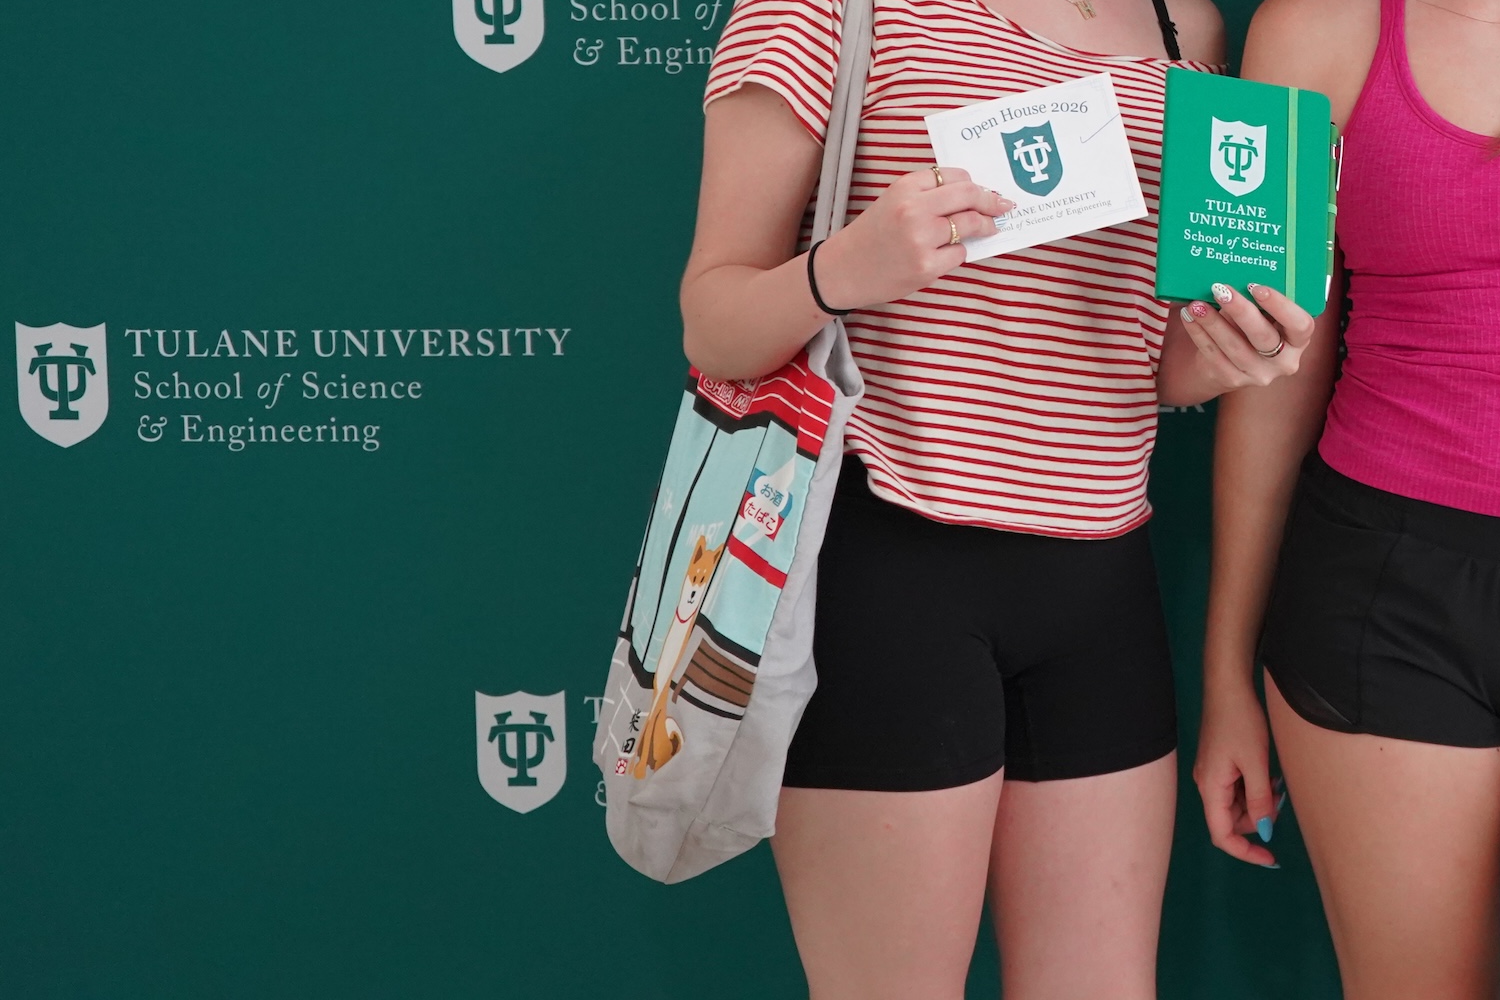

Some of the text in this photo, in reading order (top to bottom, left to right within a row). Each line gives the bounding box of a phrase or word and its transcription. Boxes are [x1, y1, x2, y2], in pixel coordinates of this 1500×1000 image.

[572, 37, 604, 66] &
[960, 100, 1089, 143] Open House 2026
[1003, 190, 1097, 221] ULANE UNIVERSITY
[1015, 221, 1025, 232] of
[1025, 213, 1054, 227] Science
[1065, 199, 1112, 217] Engineering
[1205, 198, 1267, 219] TULANE
[1189, 211, 1282, 236] UNIVERSITY
[1183, 228, 1285, 254] School of Science
[1190, 245, 1278, 271] & Engineering
[124, 327, 571, 358] TULANE UNIVERSITY
[134, 371, 422, 410] School of Science
[137, 414, 381, 452] & Engineering
